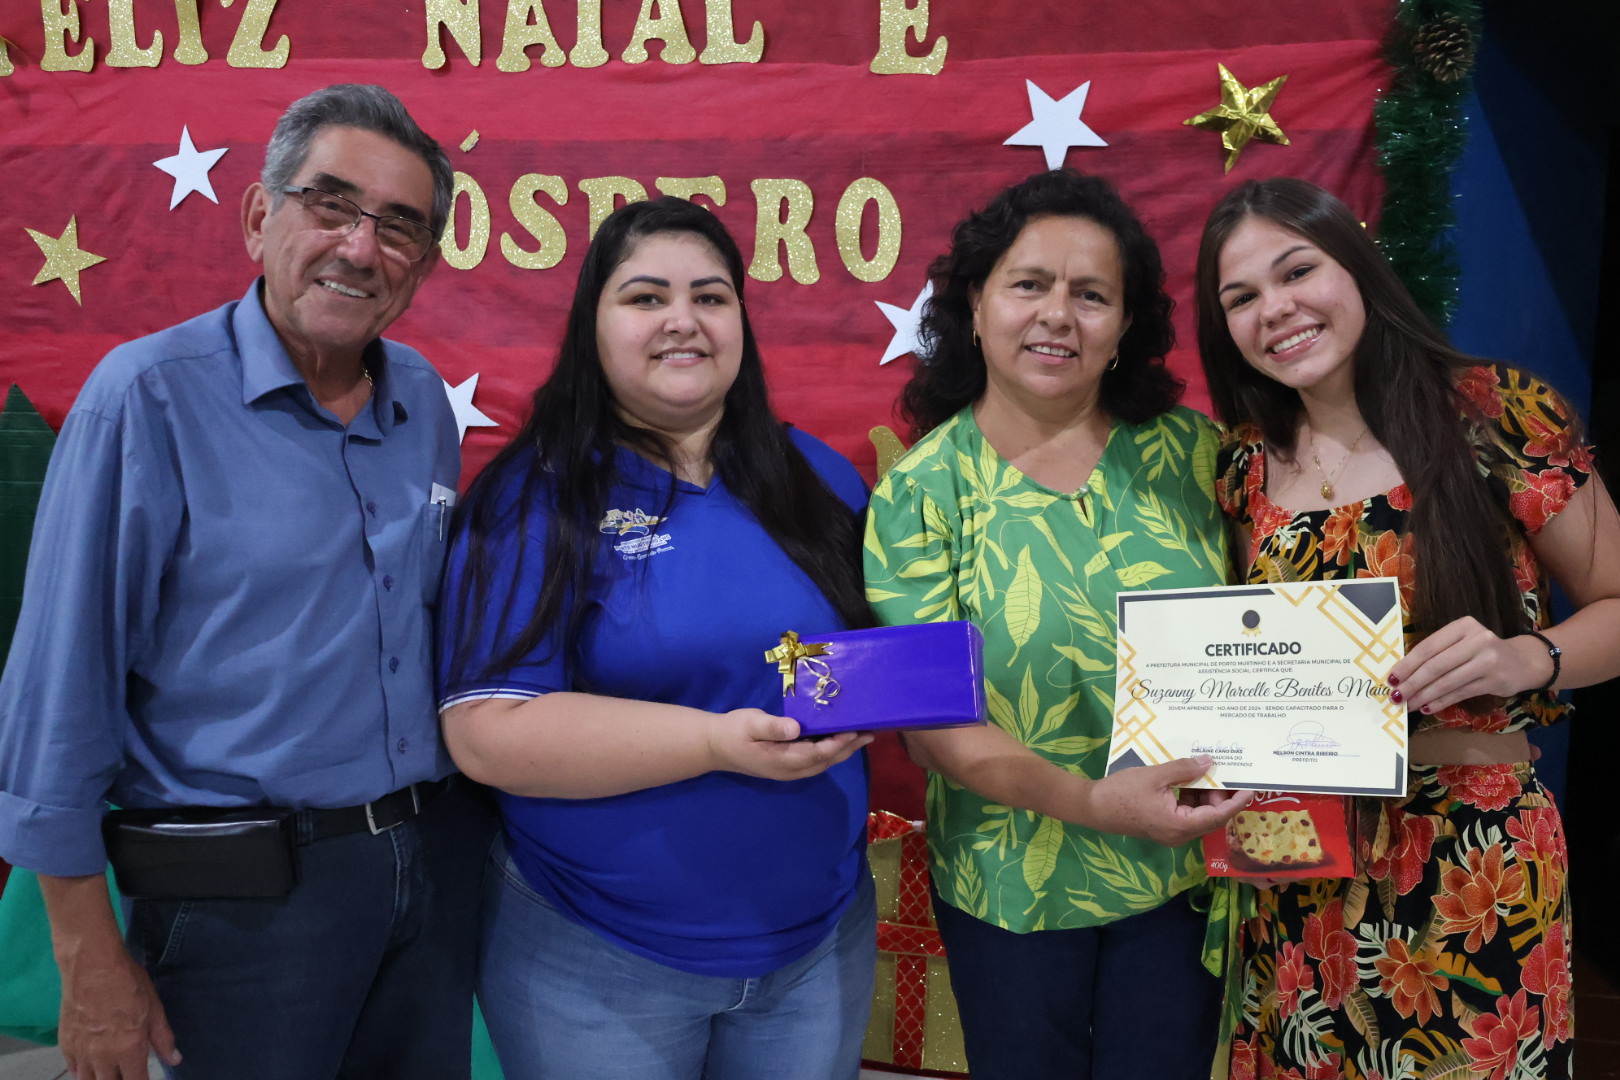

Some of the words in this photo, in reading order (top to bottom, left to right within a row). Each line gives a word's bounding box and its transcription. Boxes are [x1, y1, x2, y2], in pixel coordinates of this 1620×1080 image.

[0, 0, 290, 75] ELIZ
[869, 0, 948, 75] E
[1205, 641, 1302, 657] CERTIFICADO
[1237, 659, 1267, 667] MURTINHO
[1132, 678, 1196, 705] Suzanny
[1200, 677, 1271, 699] Marcelle
[1275, 676, 1333, 699] Benites
[1338, 675, 1391, 699] Maia
[1211, 862, 1228, 873] 400g
